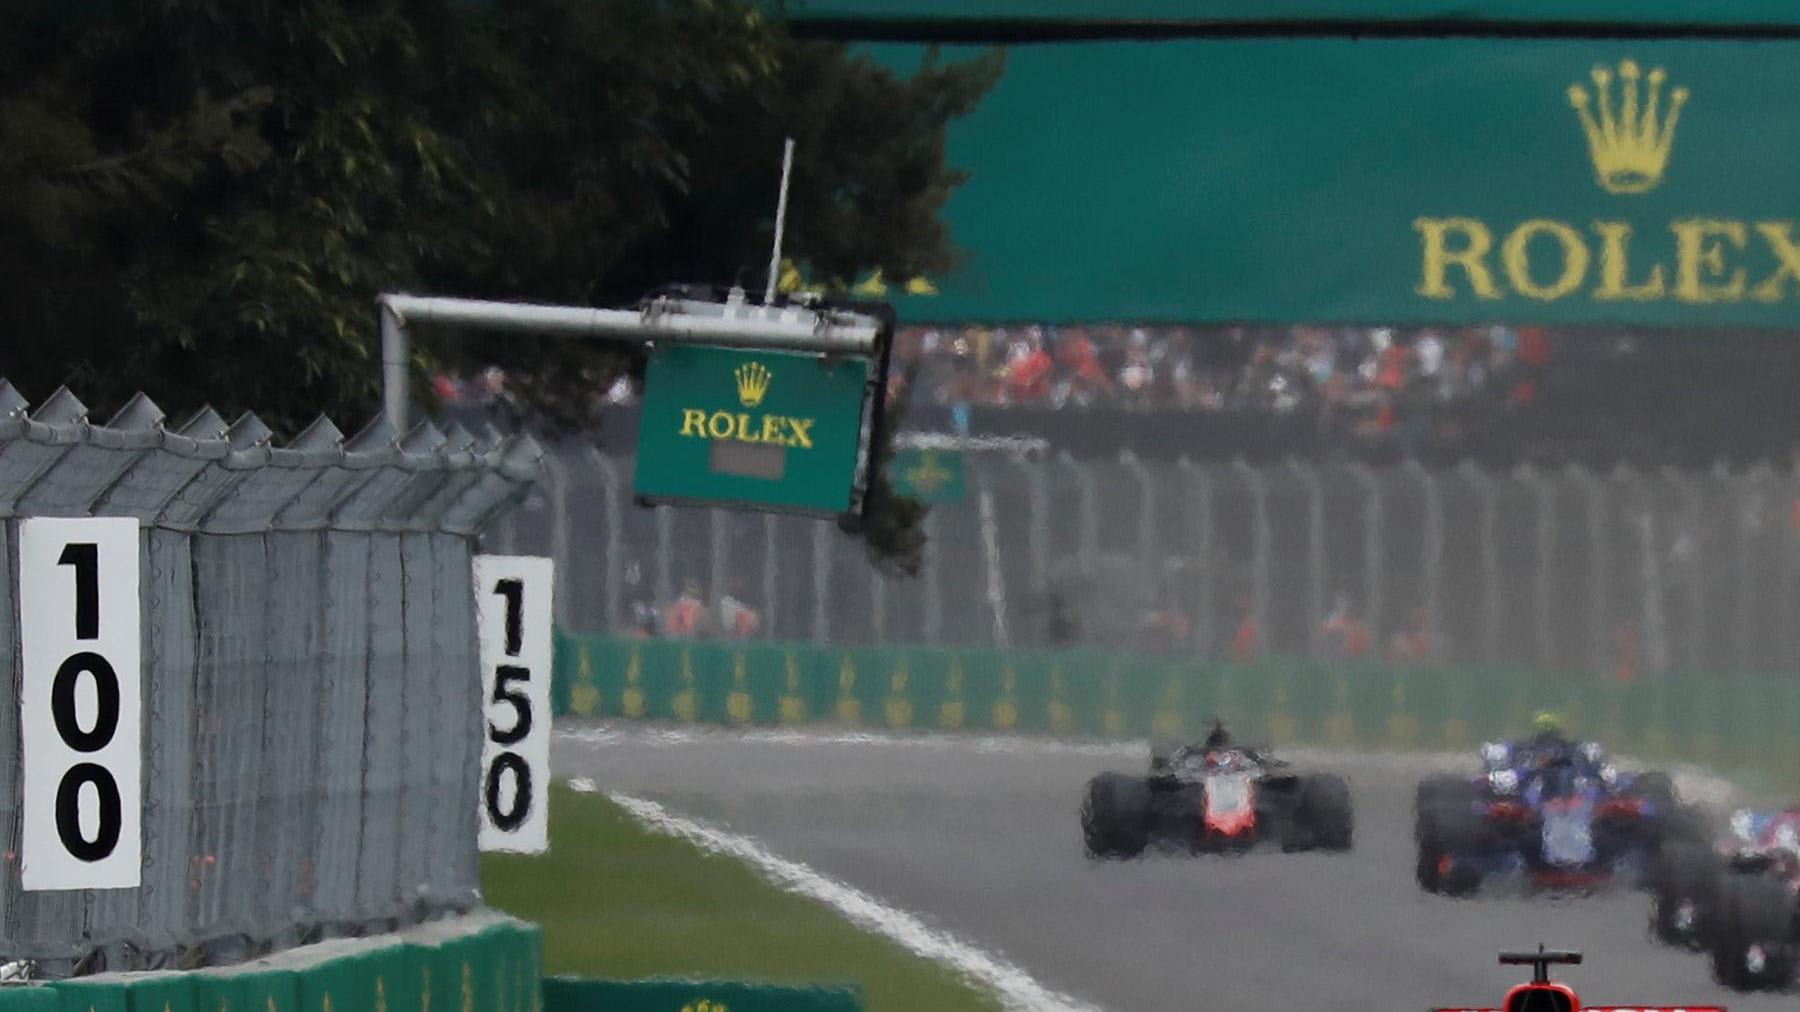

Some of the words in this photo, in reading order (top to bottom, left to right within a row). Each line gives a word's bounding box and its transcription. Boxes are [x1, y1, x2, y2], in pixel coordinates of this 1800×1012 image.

[678, 408, 816, 449] ROLEX
[51, 543, 122, 863] 100
[484, 578, 533, 833] 150
